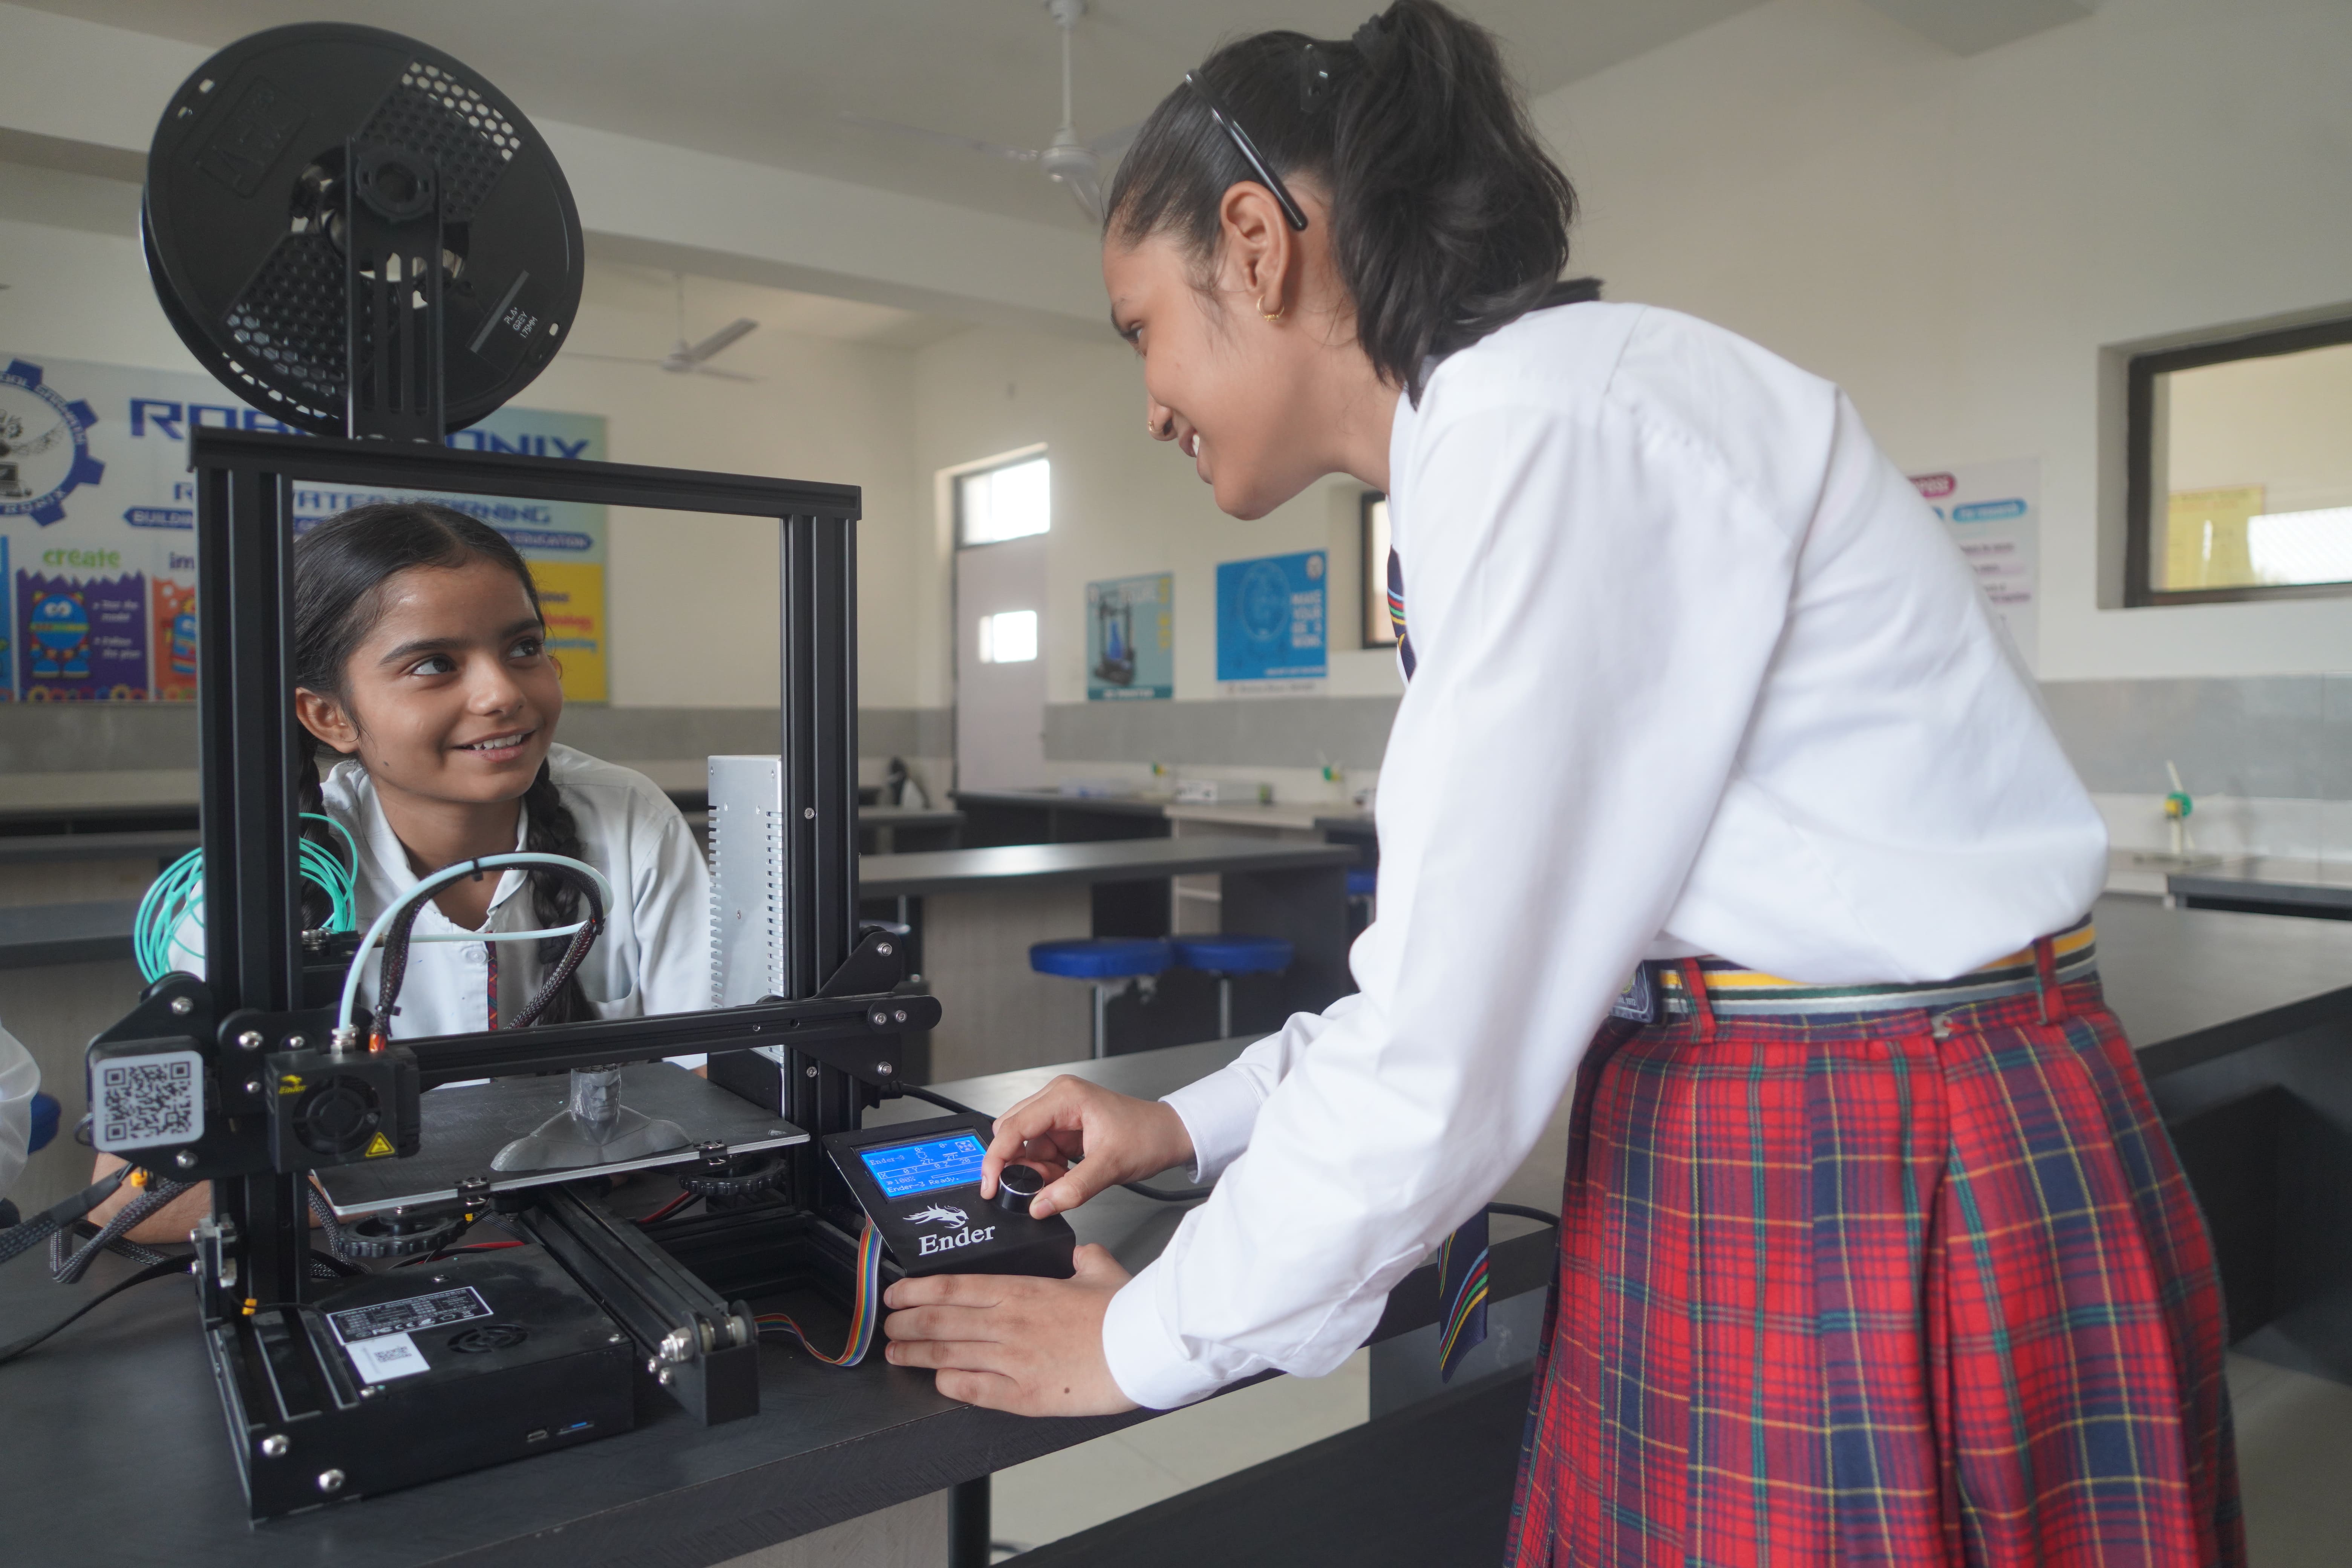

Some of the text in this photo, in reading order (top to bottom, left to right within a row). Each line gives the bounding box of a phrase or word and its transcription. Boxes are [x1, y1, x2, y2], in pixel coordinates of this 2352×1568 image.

[504, 307, 518, 325] PLA+
[513, 311, 528, 331] GREY
[520, 316, 538, 338] 1.75MM
[42, 548, 121, 568] create
[1626, 997, 1636, 1006] 1972
[869, 1155, 905, 1165] Ender-3
[887, 1177, 959, 1193] Ender-3 Ready.
[919, 1226, 995, 1256] Ender
